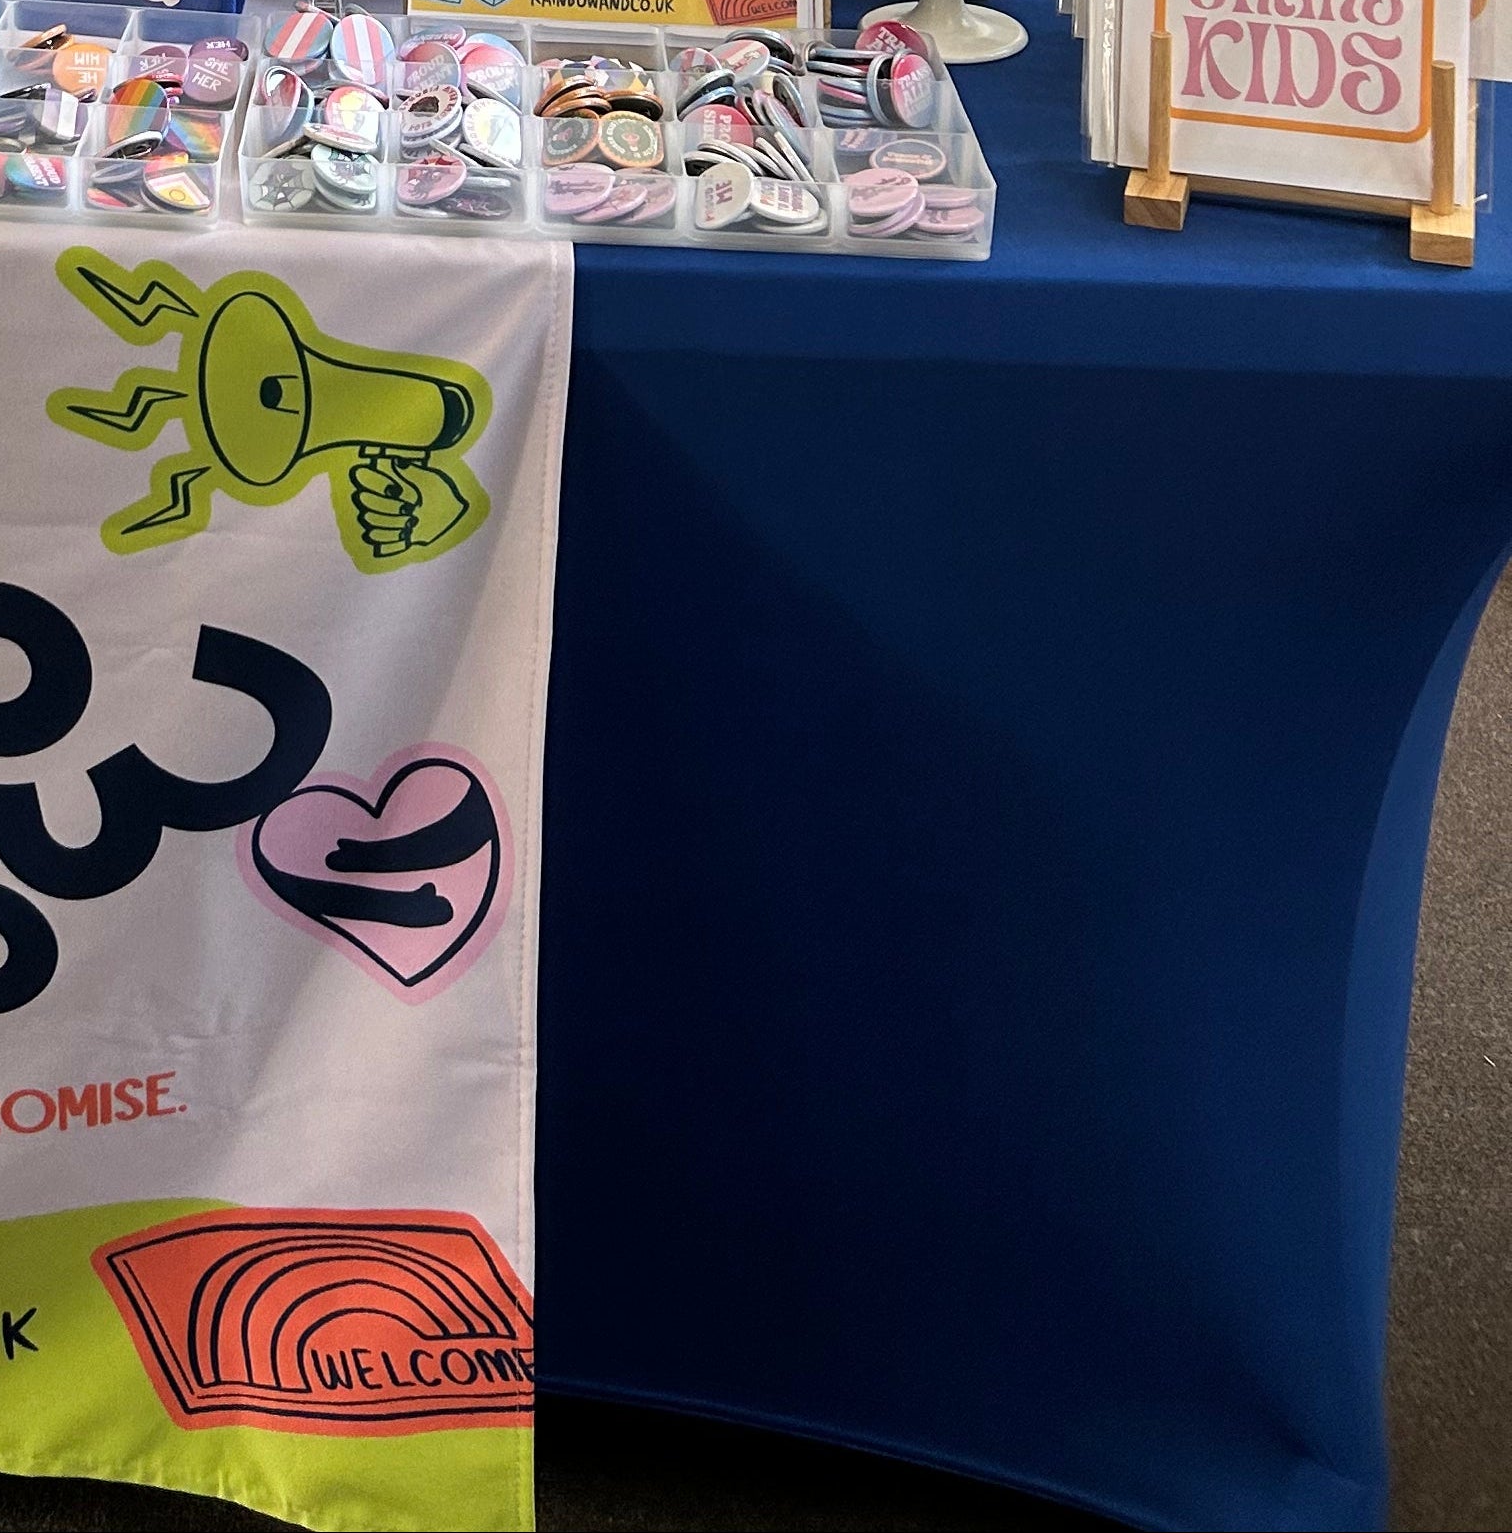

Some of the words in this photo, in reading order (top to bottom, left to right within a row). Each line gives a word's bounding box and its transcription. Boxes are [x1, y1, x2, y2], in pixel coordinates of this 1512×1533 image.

[205, 57, 229, 75] SHE
[1181, 15, 1402, 115] KIDS
[79, 71, 97, 83] HE
[192, 72, 221, 91] HER
[314, 1344, 533, 1394] WELCOME
